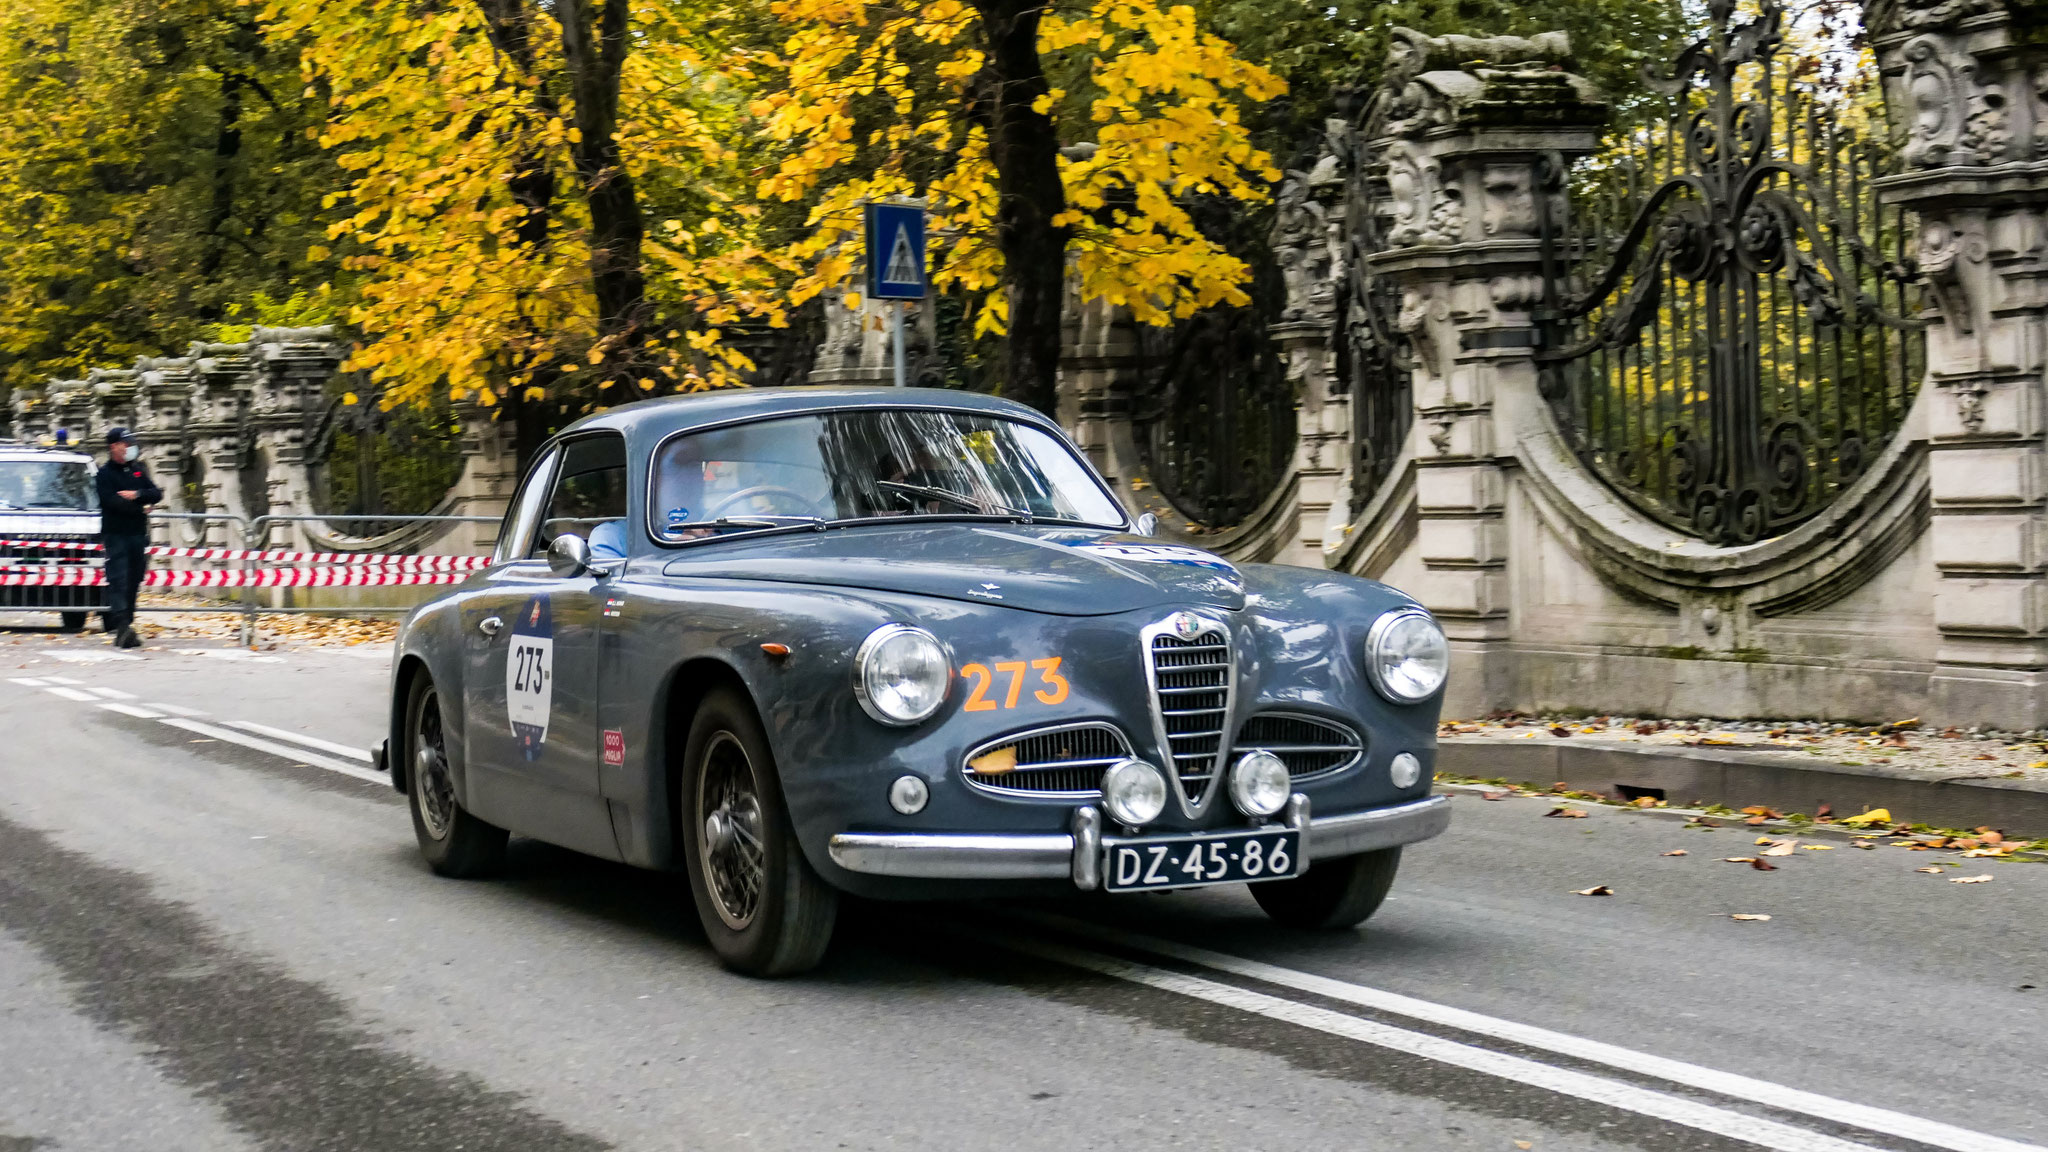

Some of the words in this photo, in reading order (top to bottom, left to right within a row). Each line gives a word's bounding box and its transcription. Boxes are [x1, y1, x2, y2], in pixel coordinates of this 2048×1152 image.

[514, 645, 544, 695] 273
[960, 656, 1069, 712] 273
[605, 734, 620, 746] 1000
[1117, 838, 1290, 885] DZ-45-86
